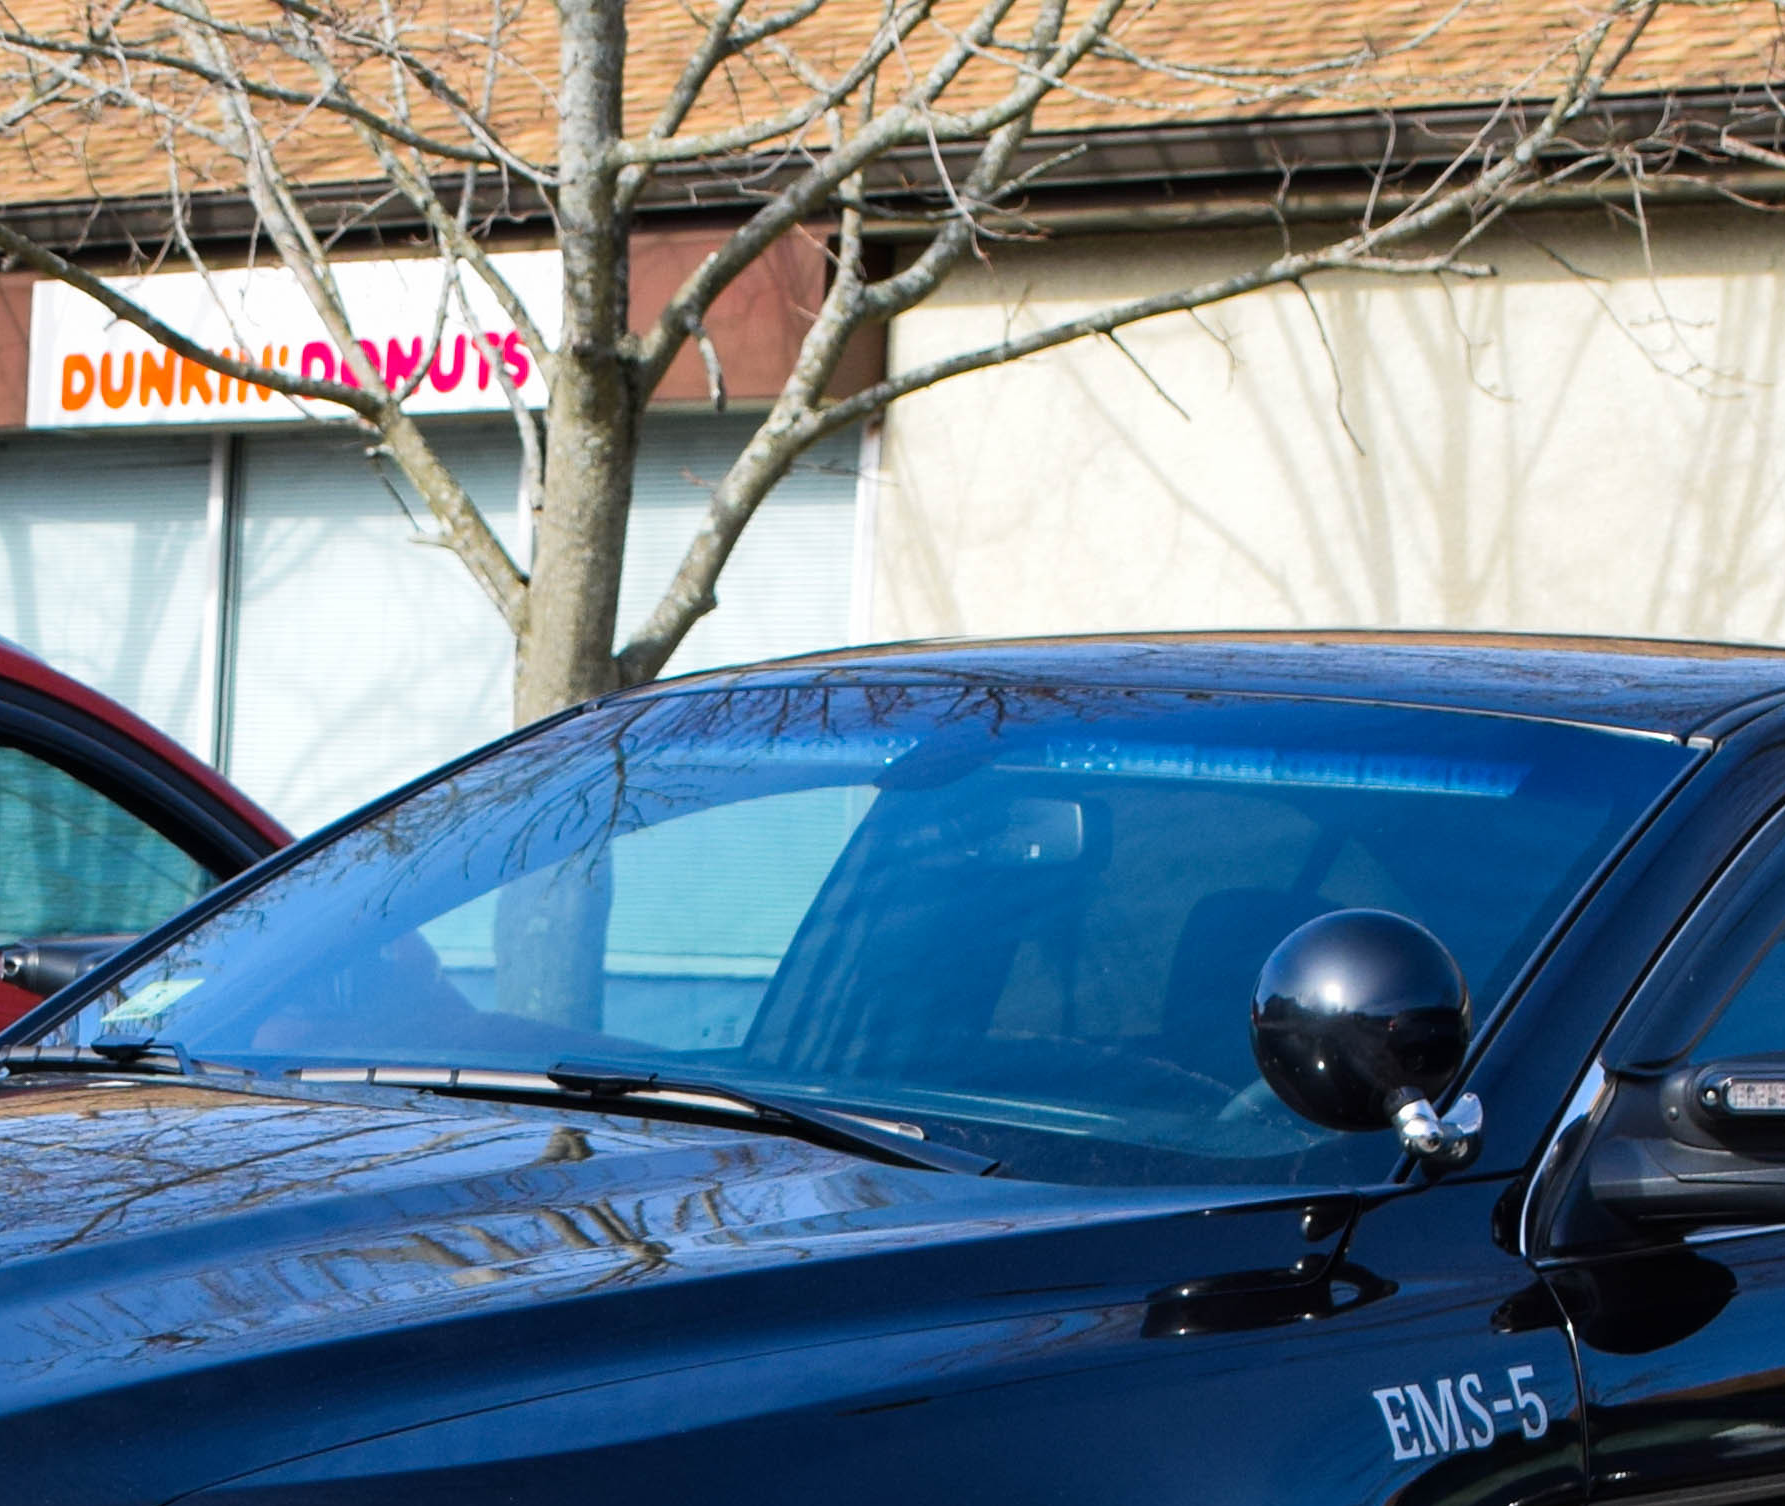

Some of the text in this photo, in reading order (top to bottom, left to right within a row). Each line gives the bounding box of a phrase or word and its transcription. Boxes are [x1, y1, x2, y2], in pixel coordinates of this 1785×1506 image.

[62, 330, 530, 412] DUNKIN' DONUTS
[1372, 1364, 1548, 1461] EMS-5
